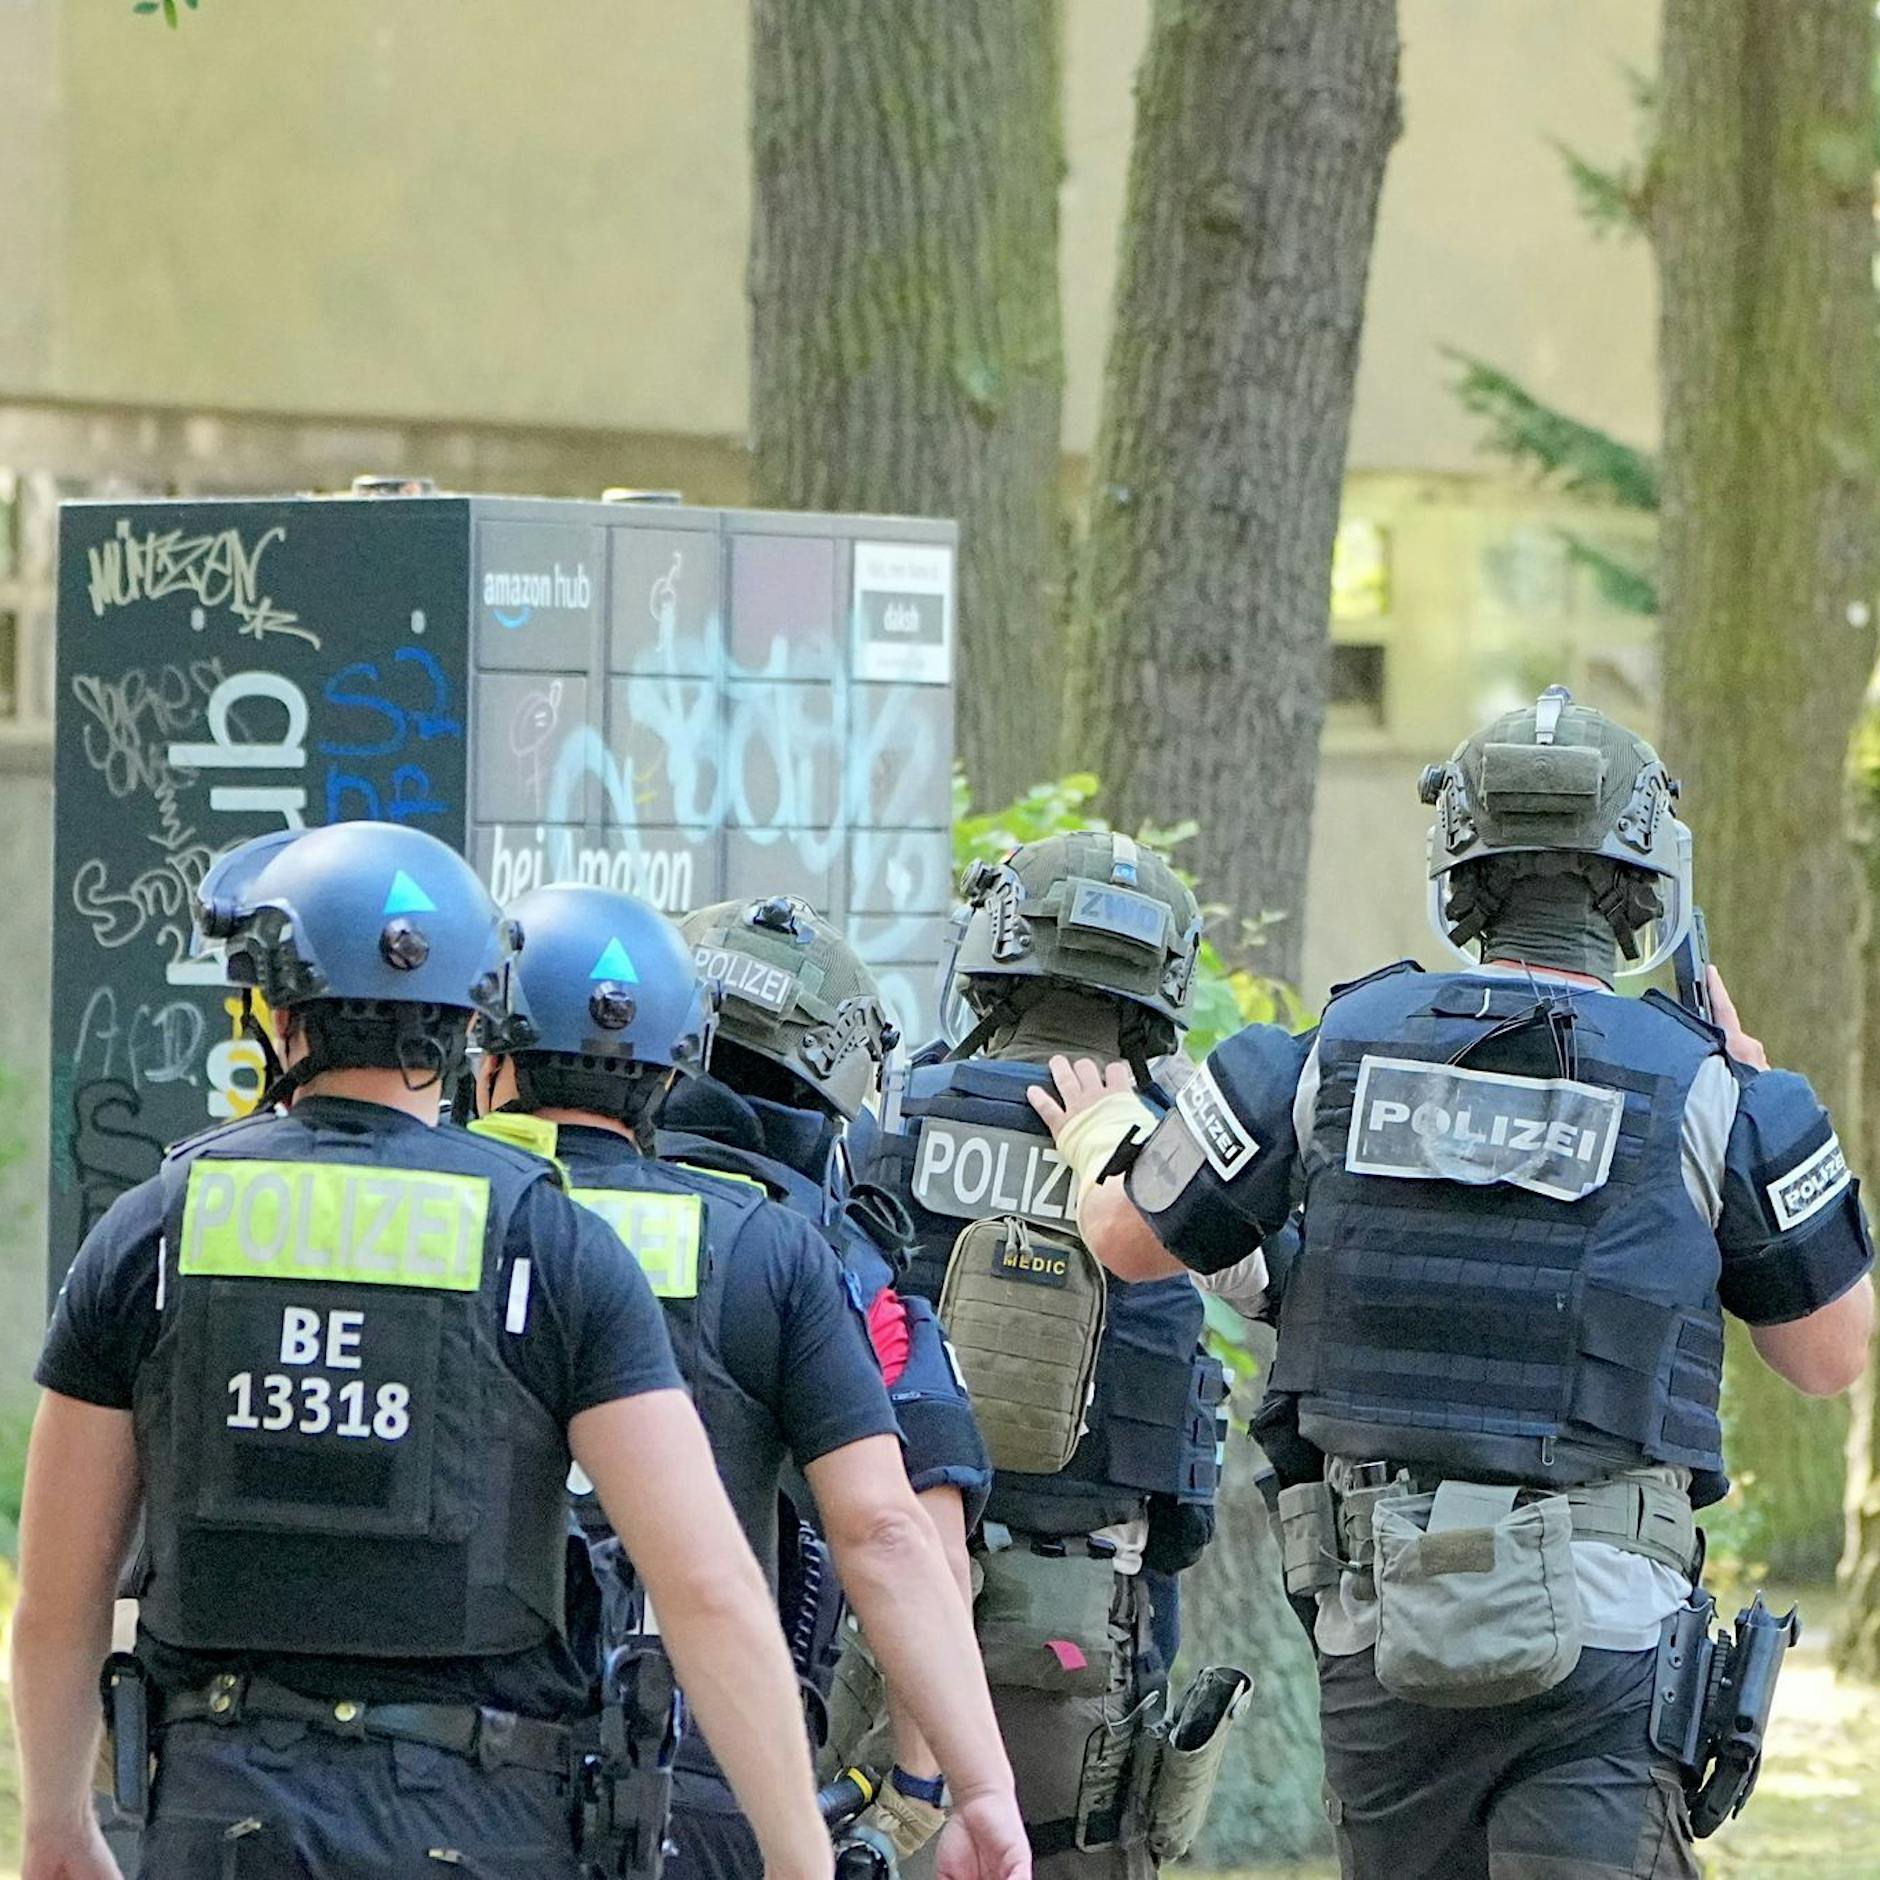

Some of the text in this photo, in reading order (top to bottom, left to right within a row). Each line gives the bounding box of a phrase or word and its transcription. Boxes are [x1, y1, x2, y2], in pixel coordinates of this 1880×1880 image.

[483, 563, 590, 609] amazon hub
[491, 825, 544, 908] bei
[694, 948, 791, 1005] POLIZEI
[1187, 1077, 1239, 1160] POLIZEI
[1369, 1100, 1597, 1162] POLIZEI
[917, 1130, 1079, 1221] POLIZ
[1785, 1151, 1846, 1211] POLIZE
[190, 1172, 476, 1276] POLIZEI
[1003, 1253, 1066, 1276] MEDIC
[280, 1306, 365, 1370] BE
[226, 1372, 411, 1441] 13318
